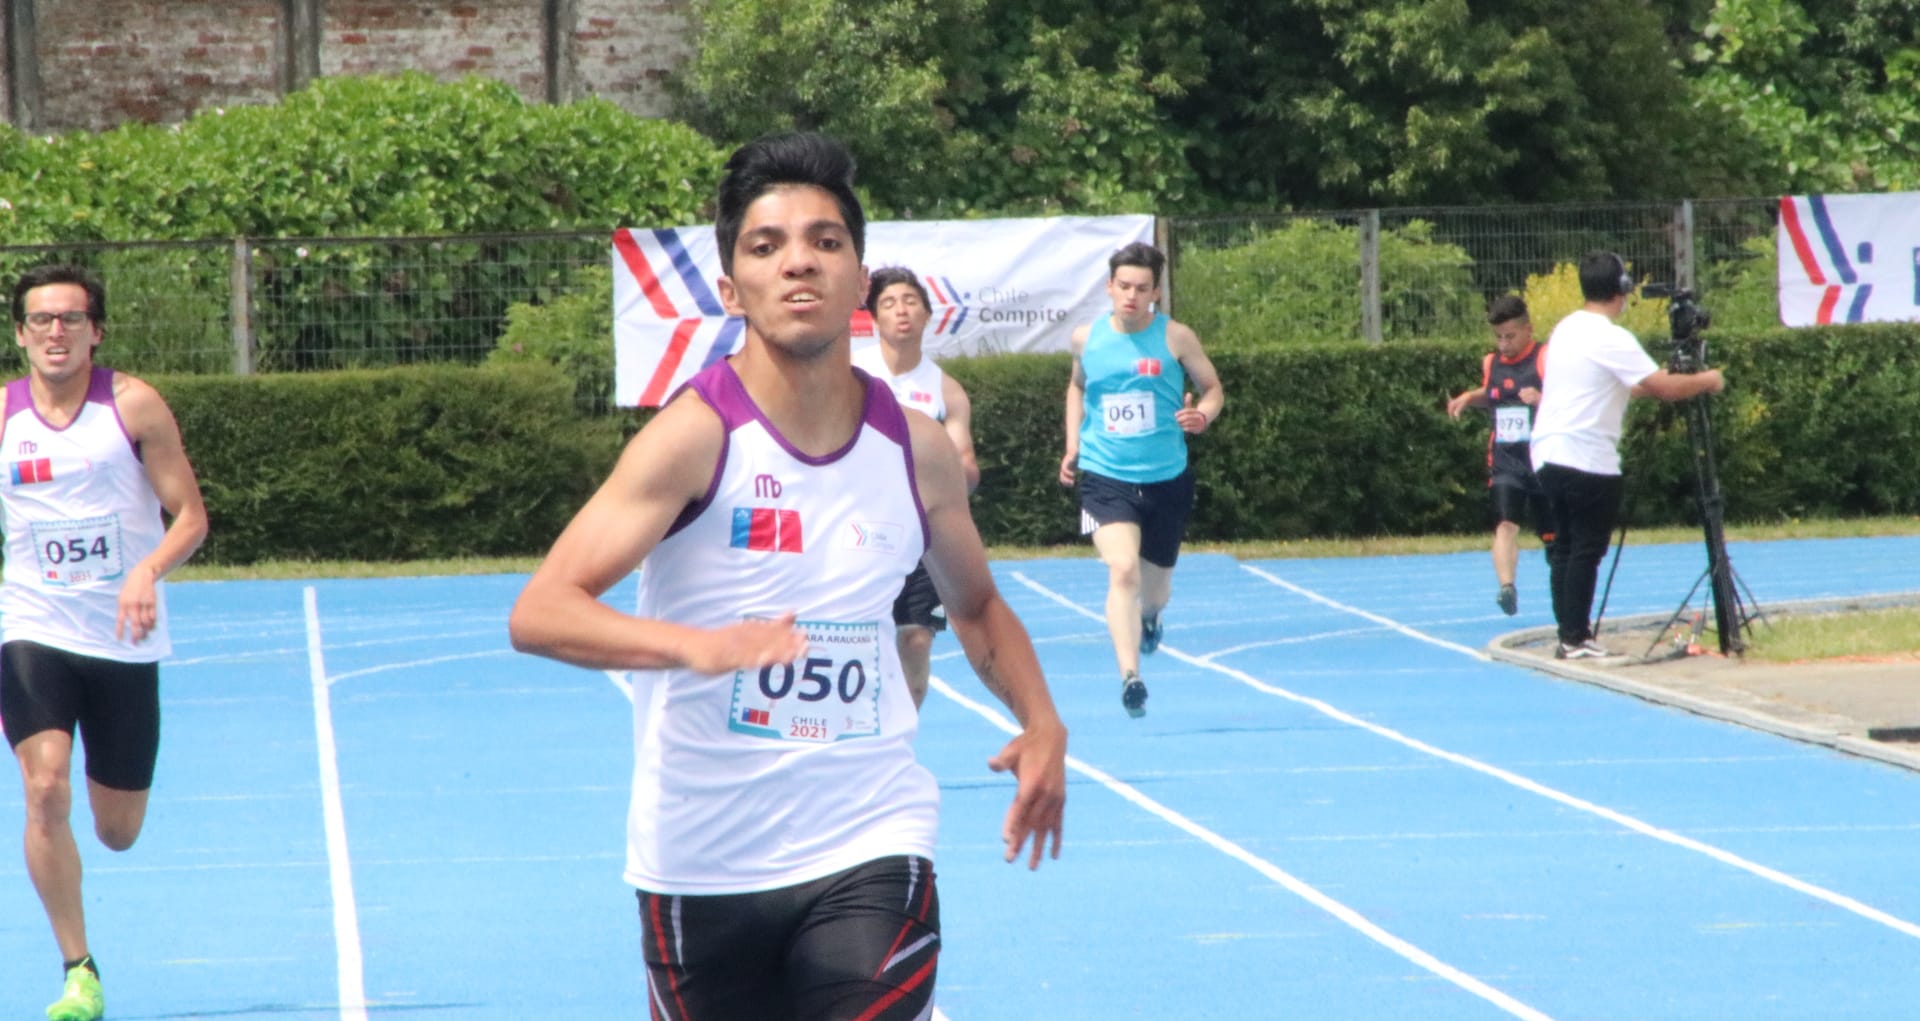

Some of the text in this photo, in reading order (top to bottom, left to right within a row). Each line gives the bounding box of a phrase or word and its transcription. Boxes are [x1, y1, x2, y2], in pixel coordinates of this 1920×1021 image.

[979, 286, 1029, 304] Chile
[979, 307, 1067, 328] Compite
[1109, 404, 1145, 422] 061
[46, 535, 110, 565] 054
[804, 633, 825, 643] ARA
[758, 656, 866, 704] 050
[791, 715, 828, 726] CHILE
[789, 724, 828, 739] 2021
